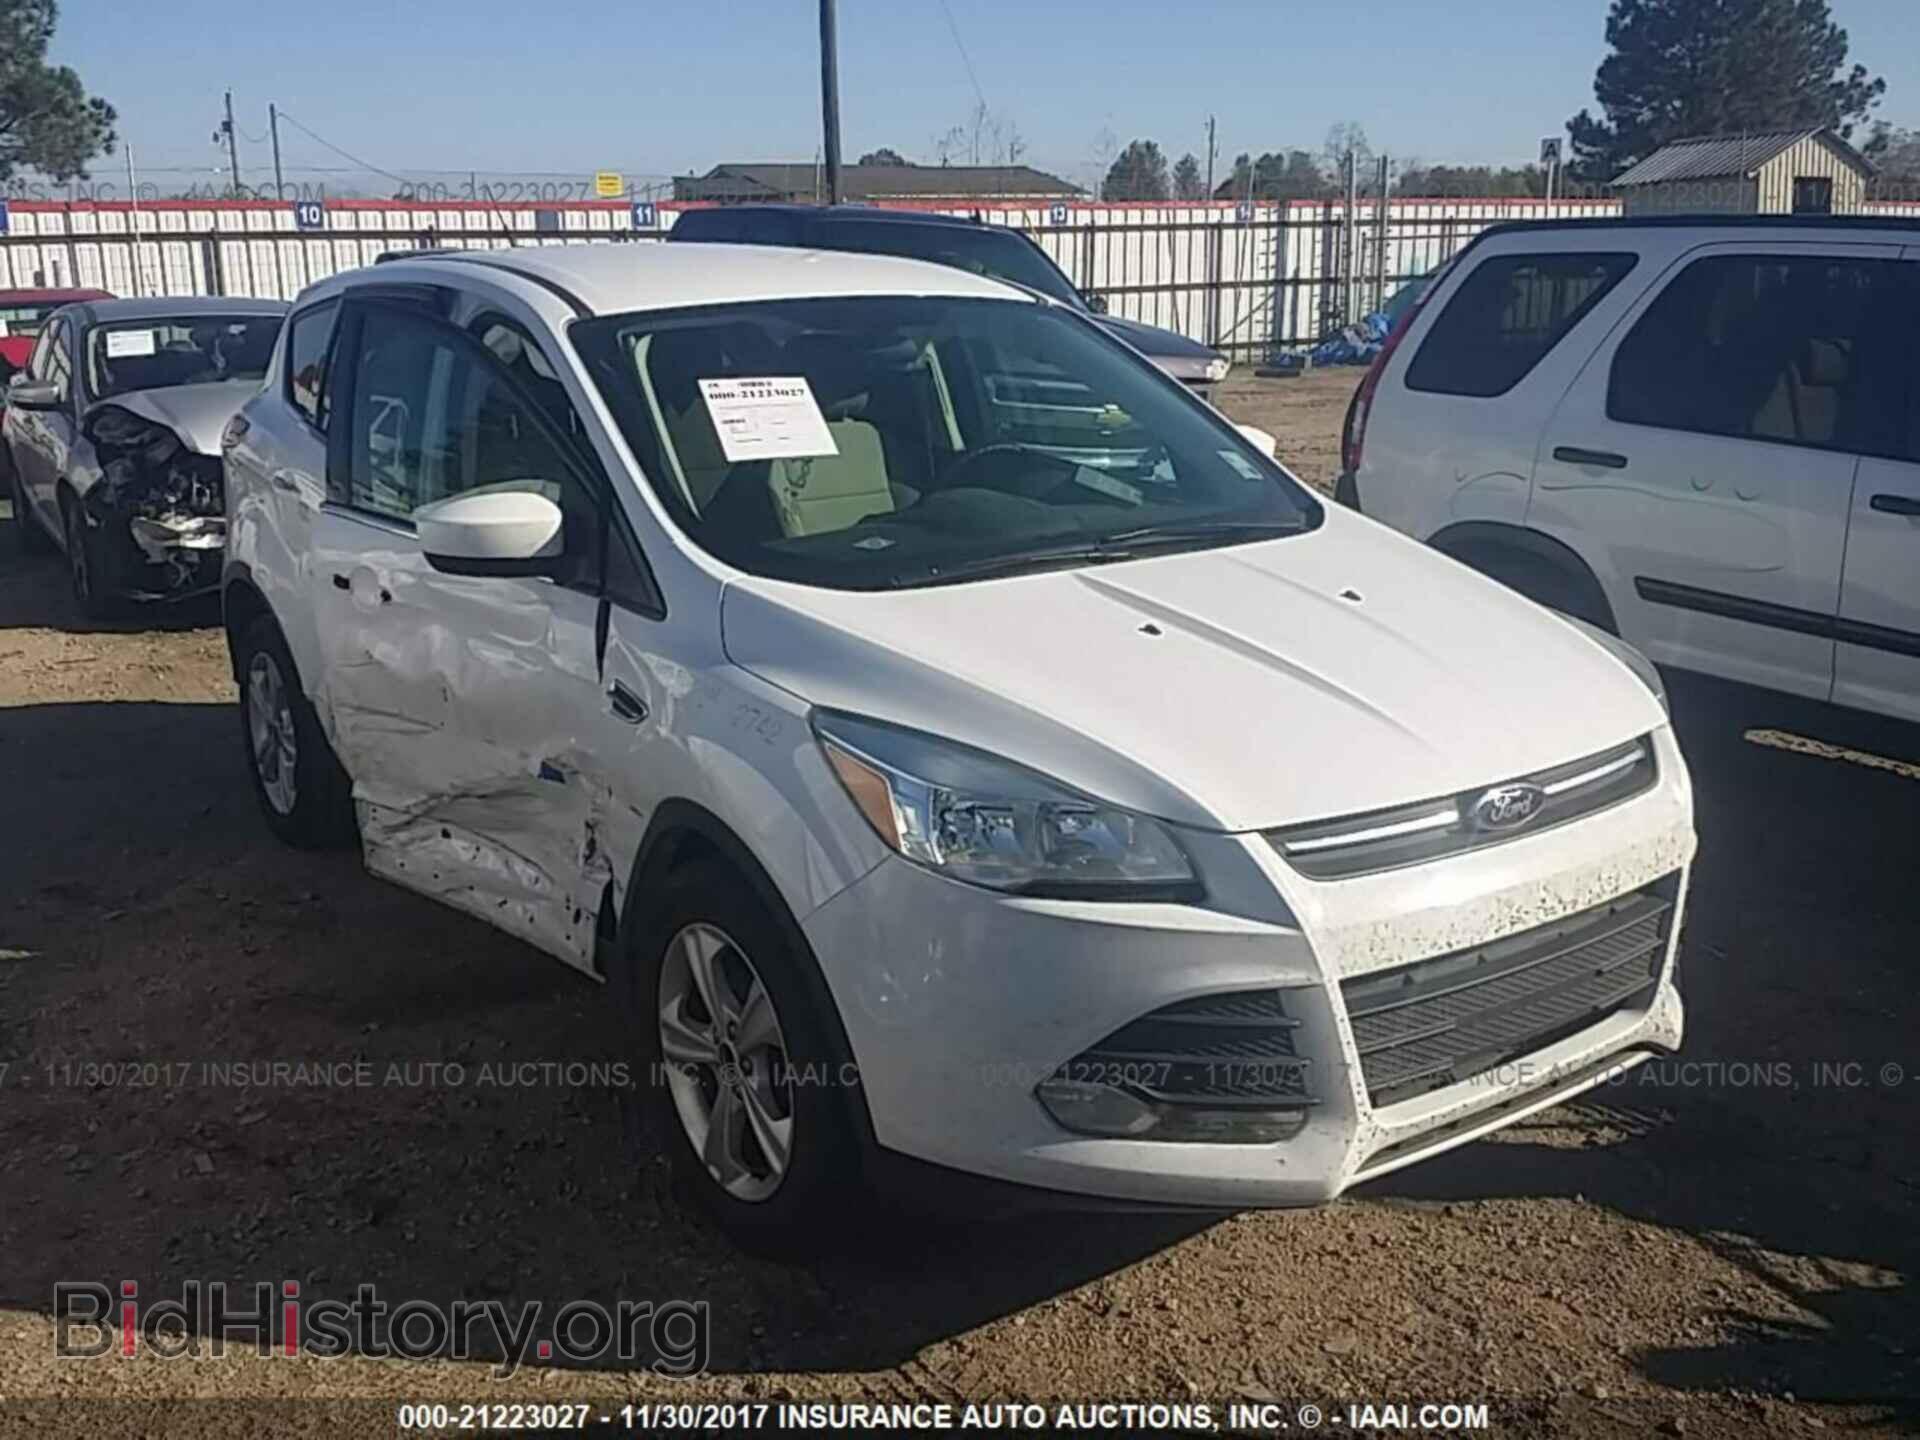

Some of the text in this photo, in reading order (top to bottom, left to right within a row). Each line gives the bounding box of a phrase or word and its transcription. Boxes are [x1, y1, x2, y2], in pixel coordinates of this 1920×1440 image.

[300, 206, 320, 224] 10
[636, 206, 651, 223] 11
[1490, 789, 1534, 822] Ford
